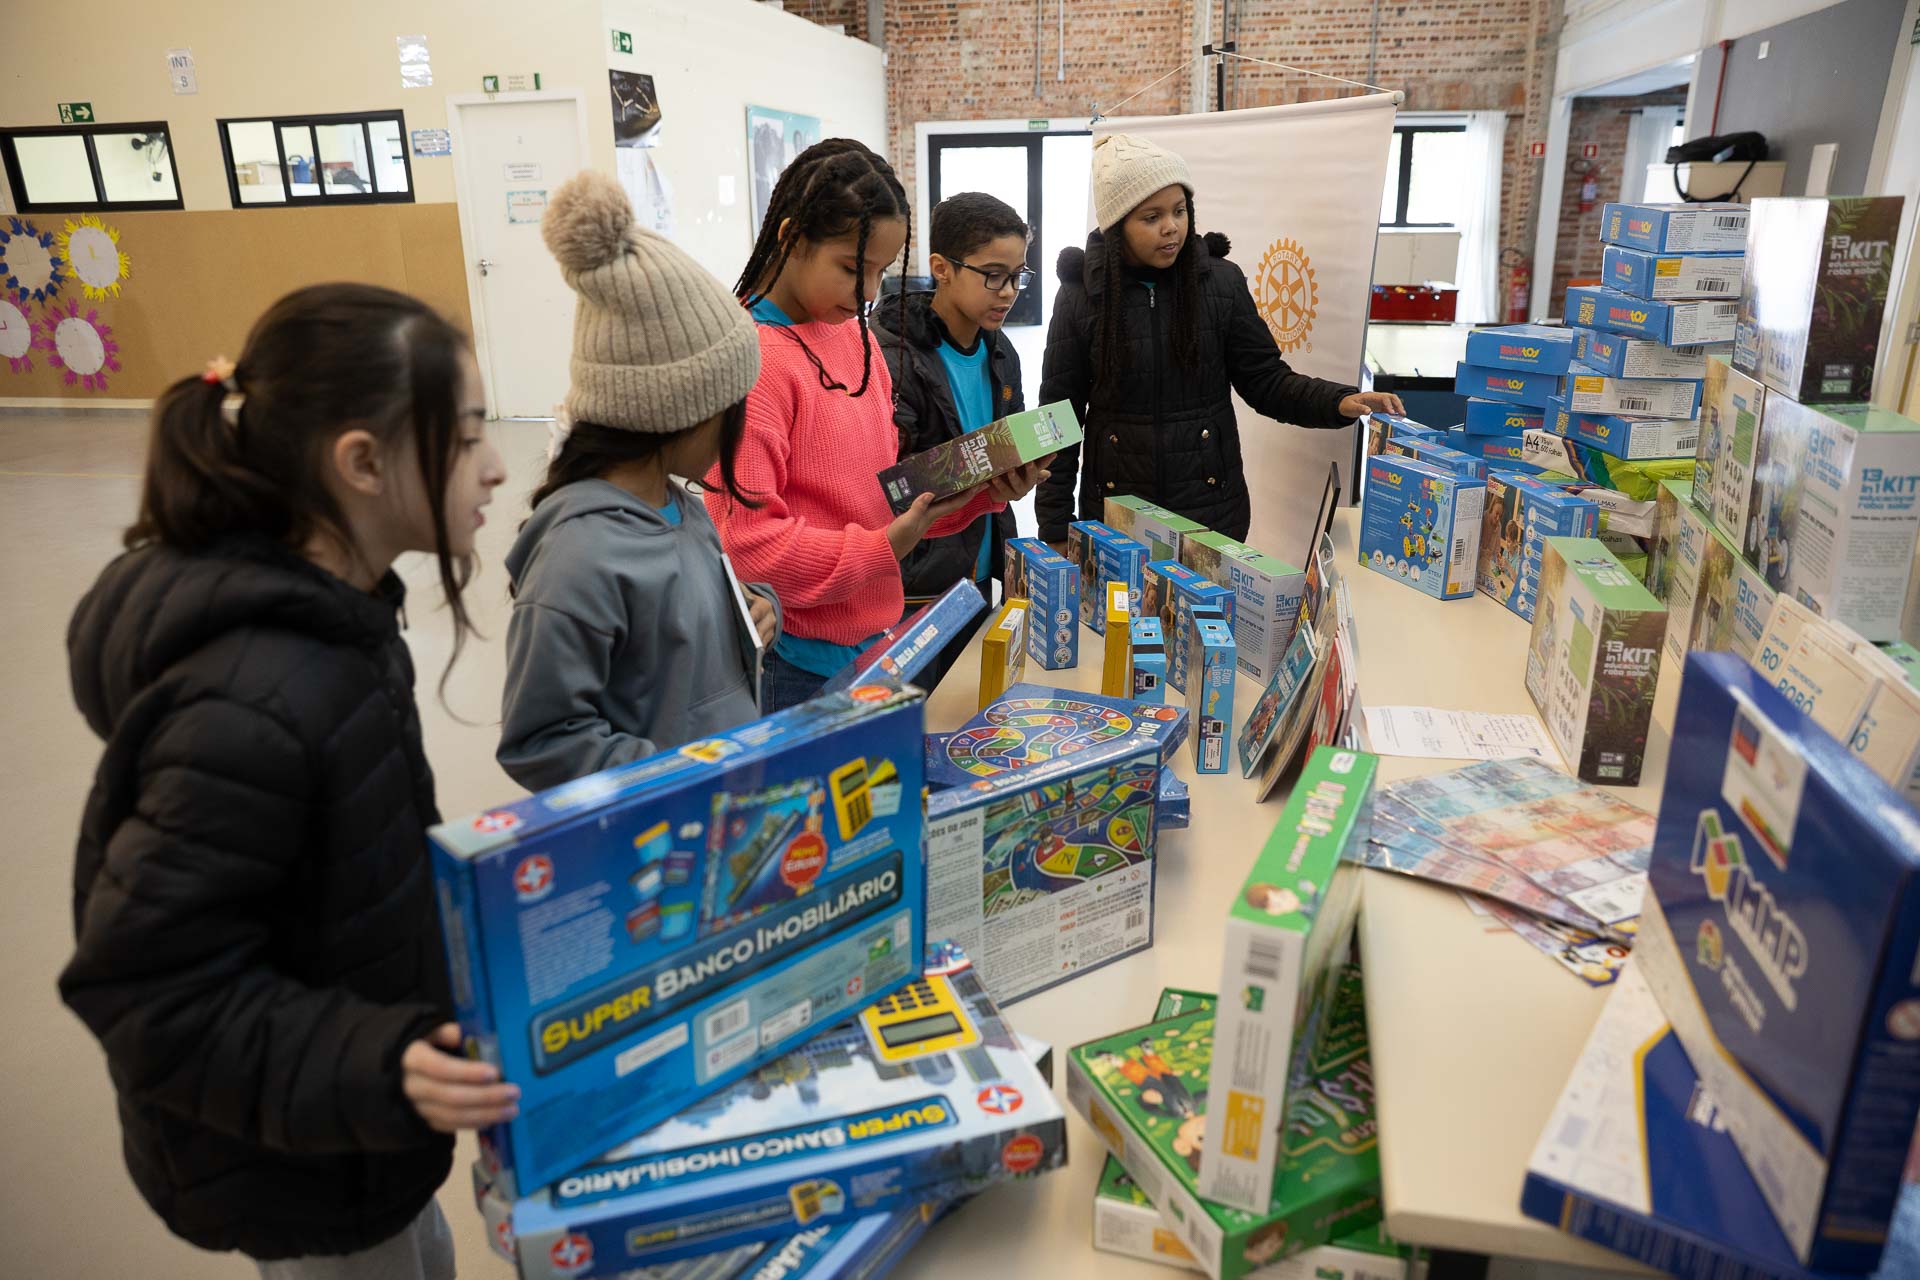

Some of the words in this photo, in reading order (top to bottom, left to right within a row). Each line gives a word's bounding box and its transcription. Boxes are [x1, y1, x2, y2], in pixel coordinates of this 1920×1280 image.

[1272, 251, 1299, 264] ROTARY
[1830, 235, 1851, 249] 13
[1849, 241, 1888, 259] KIT
[1263, 311, 1307, 340] INTERNATIONAL
[1525, 434, 1540, 451] A4
[974, 445, 993, 473] KIT
[1862, 468, 1882, 481] 13
[1883, 475, 1920, 492] KIT
[1422, 489, 1450, 507] STEM
[1230, 566, 1241, 583] 13
[1241, 572, 1255, 588] KIT
[1276, 594, 1285, 603] 13
[1284, 596, 1300, 606] KIT
[1747, 588, 1759, 611] KIT
[1605, 640, 1624, 653] 13
[1623, 647, 1656, 663] KIT
[1223, 667, 1233, 685] EQUI
[542, 986, 650, 1053] SUPER
[654, 940, 754, 1000] BANCO
[756, 870, 896, 954] IMOBILIÁRIO
[848, 1103, 948, 1140] SUPER
[742, 1127, 846, 1159] BANCO
[558, 1150, 740, 1198] IMOBILIÁRIO
